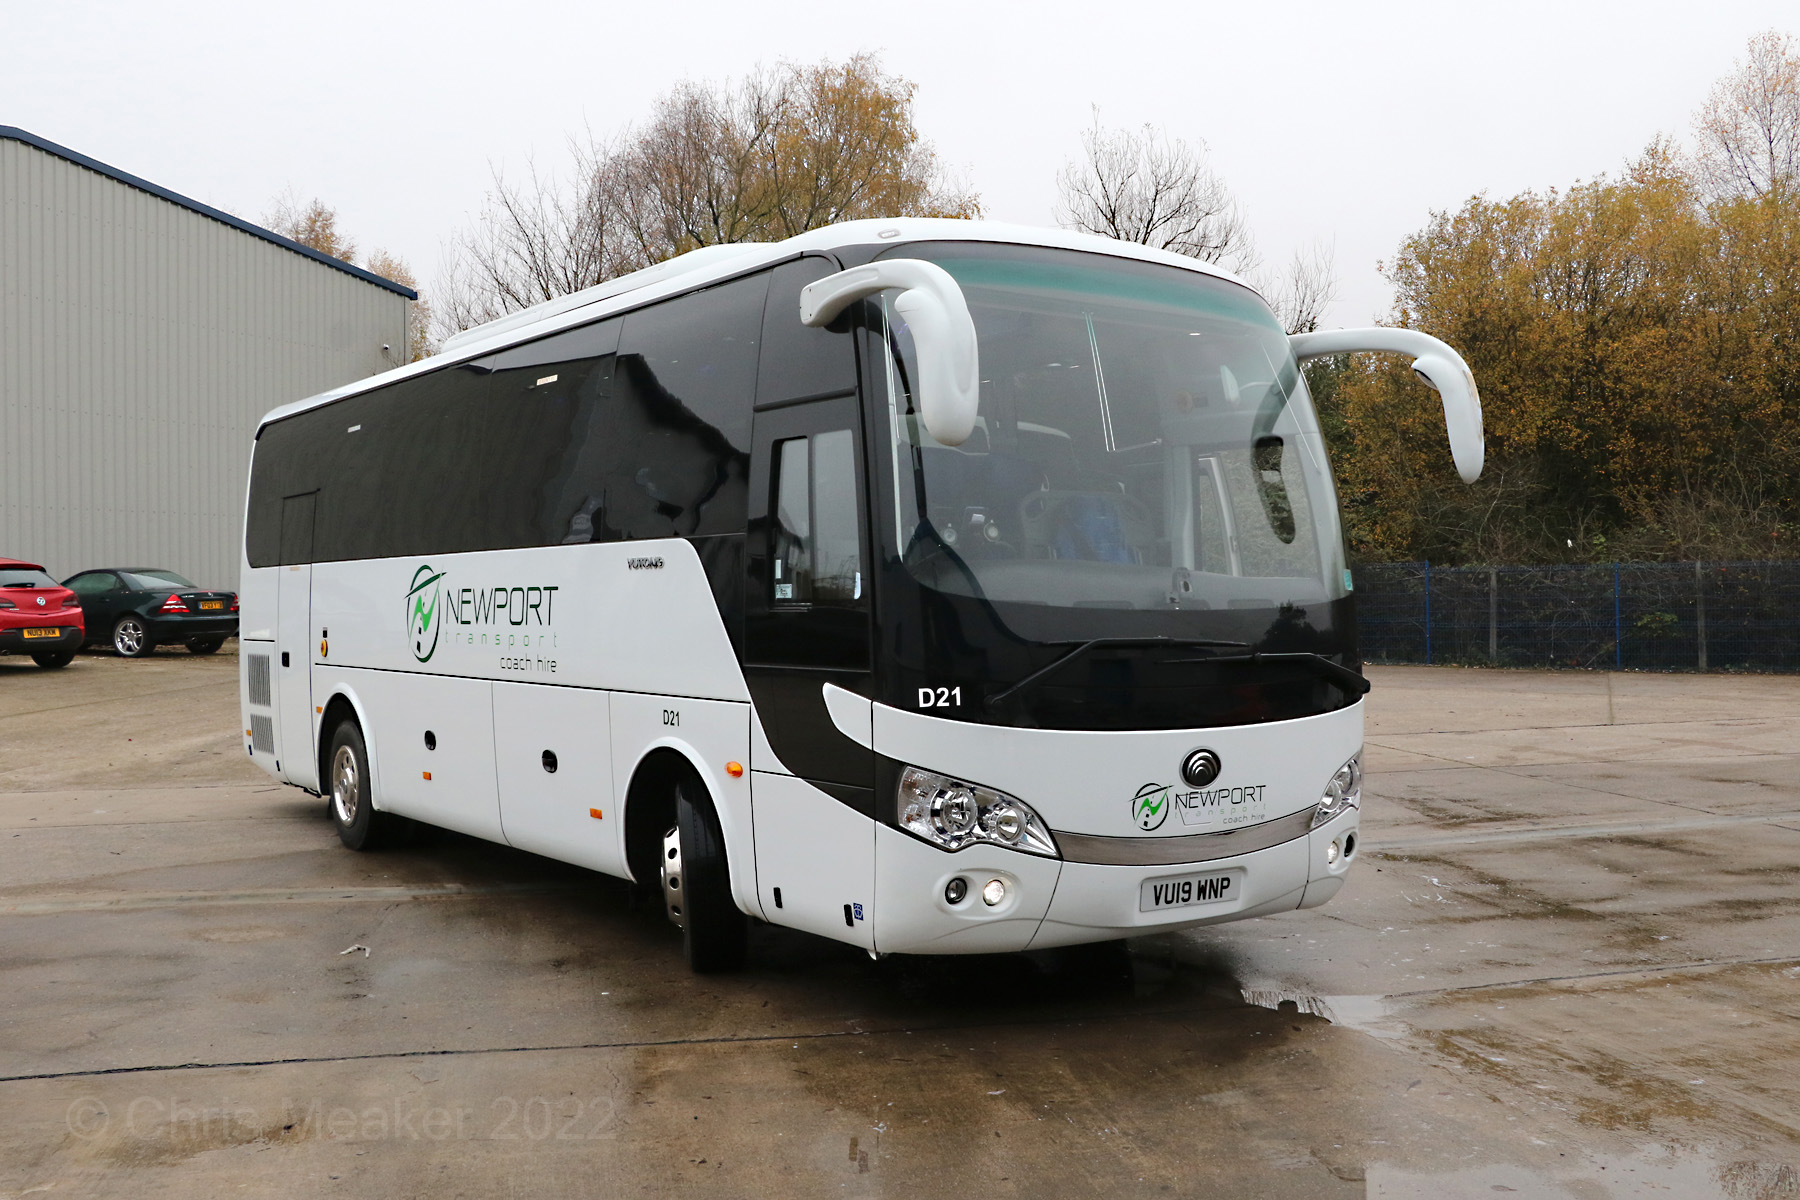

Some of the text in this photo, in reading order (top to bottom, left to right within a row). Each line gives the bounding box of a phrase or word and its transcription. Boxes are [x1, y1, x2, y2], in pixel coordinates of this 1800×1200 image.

[446, 586, 559, 626] NEWPORT
[445, 631, 558, 650] transport
[500, 654, 557, 673] coach hire
[918, 686, 961, 708] D21
[663, 709, 680, 727] D21
[1175, 785, 1266, 810] NEWPORT
[1175, 803, 1266, 819] transport
[1223, 812, 1265, 824] coach hire
[1153, 877, 1231, 906] VU19 WNP
